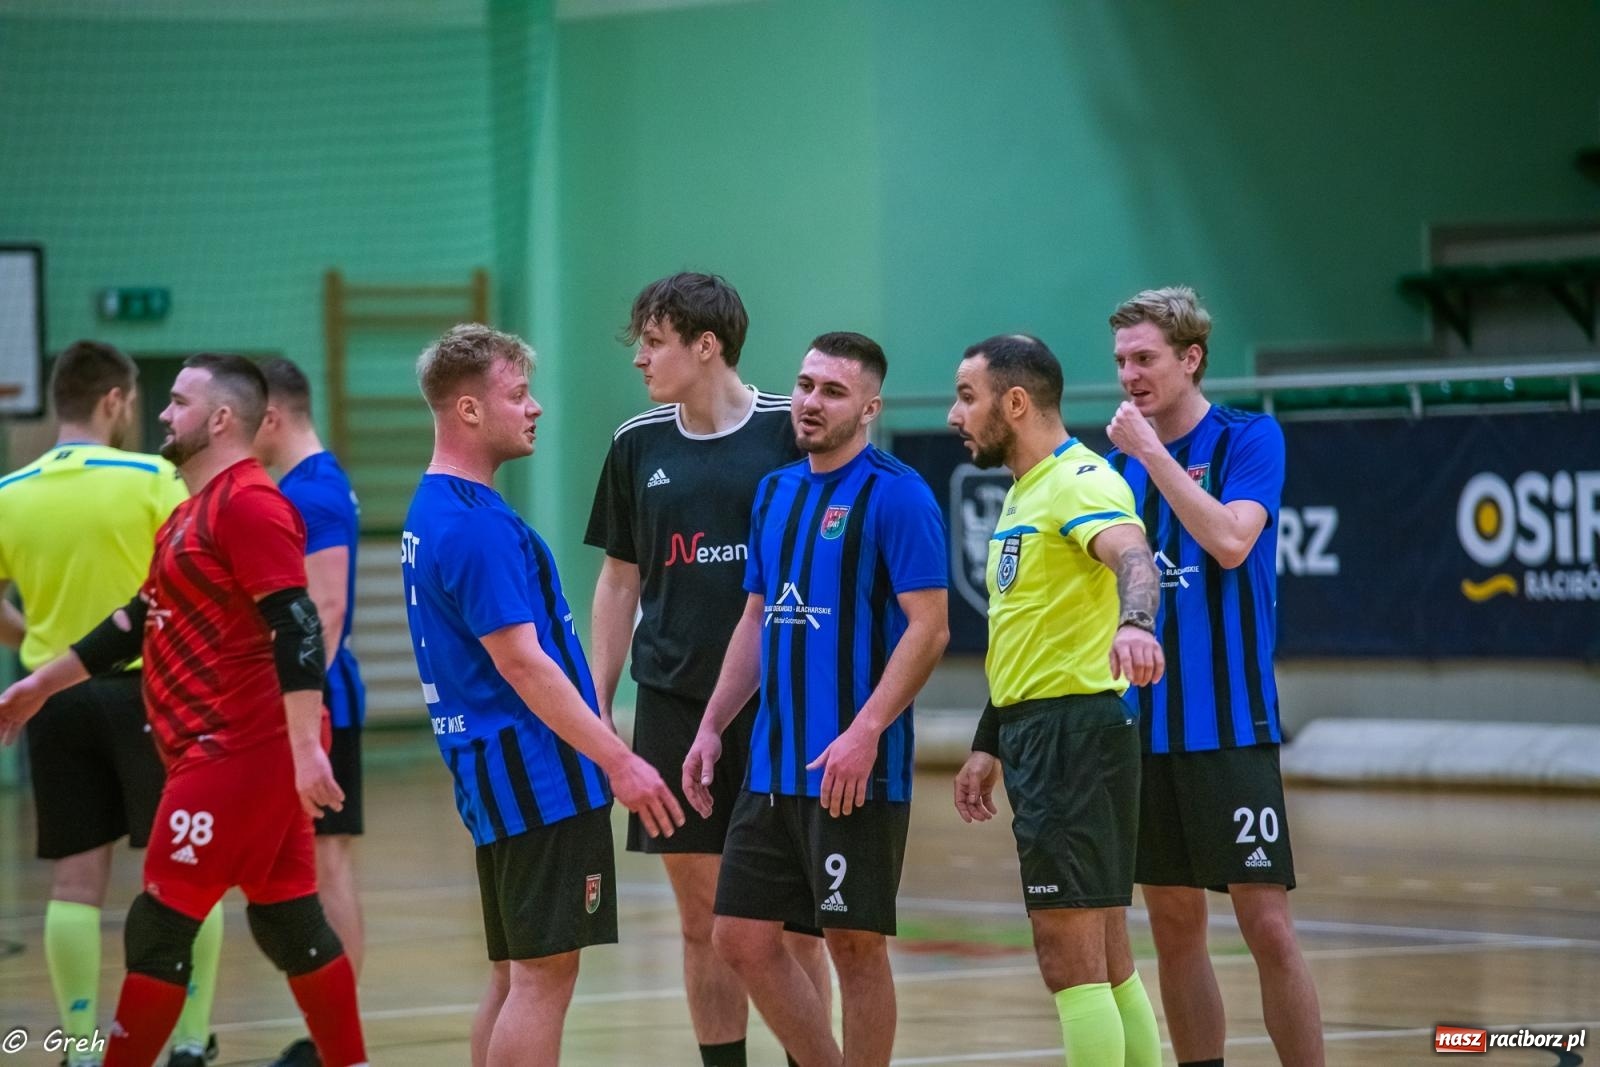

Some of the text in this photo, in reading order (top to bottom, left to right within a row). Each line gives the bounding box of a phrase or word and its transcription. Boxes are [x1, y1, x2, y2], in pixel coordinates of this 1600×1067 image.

[1275, 505, 1341, 577] RZ
[169, 809, 214, 847] 98
[1233, 806, 1279, 844] 20
[825, 853, 847, 890] 9
[821, 903, 848, 912] adidas
